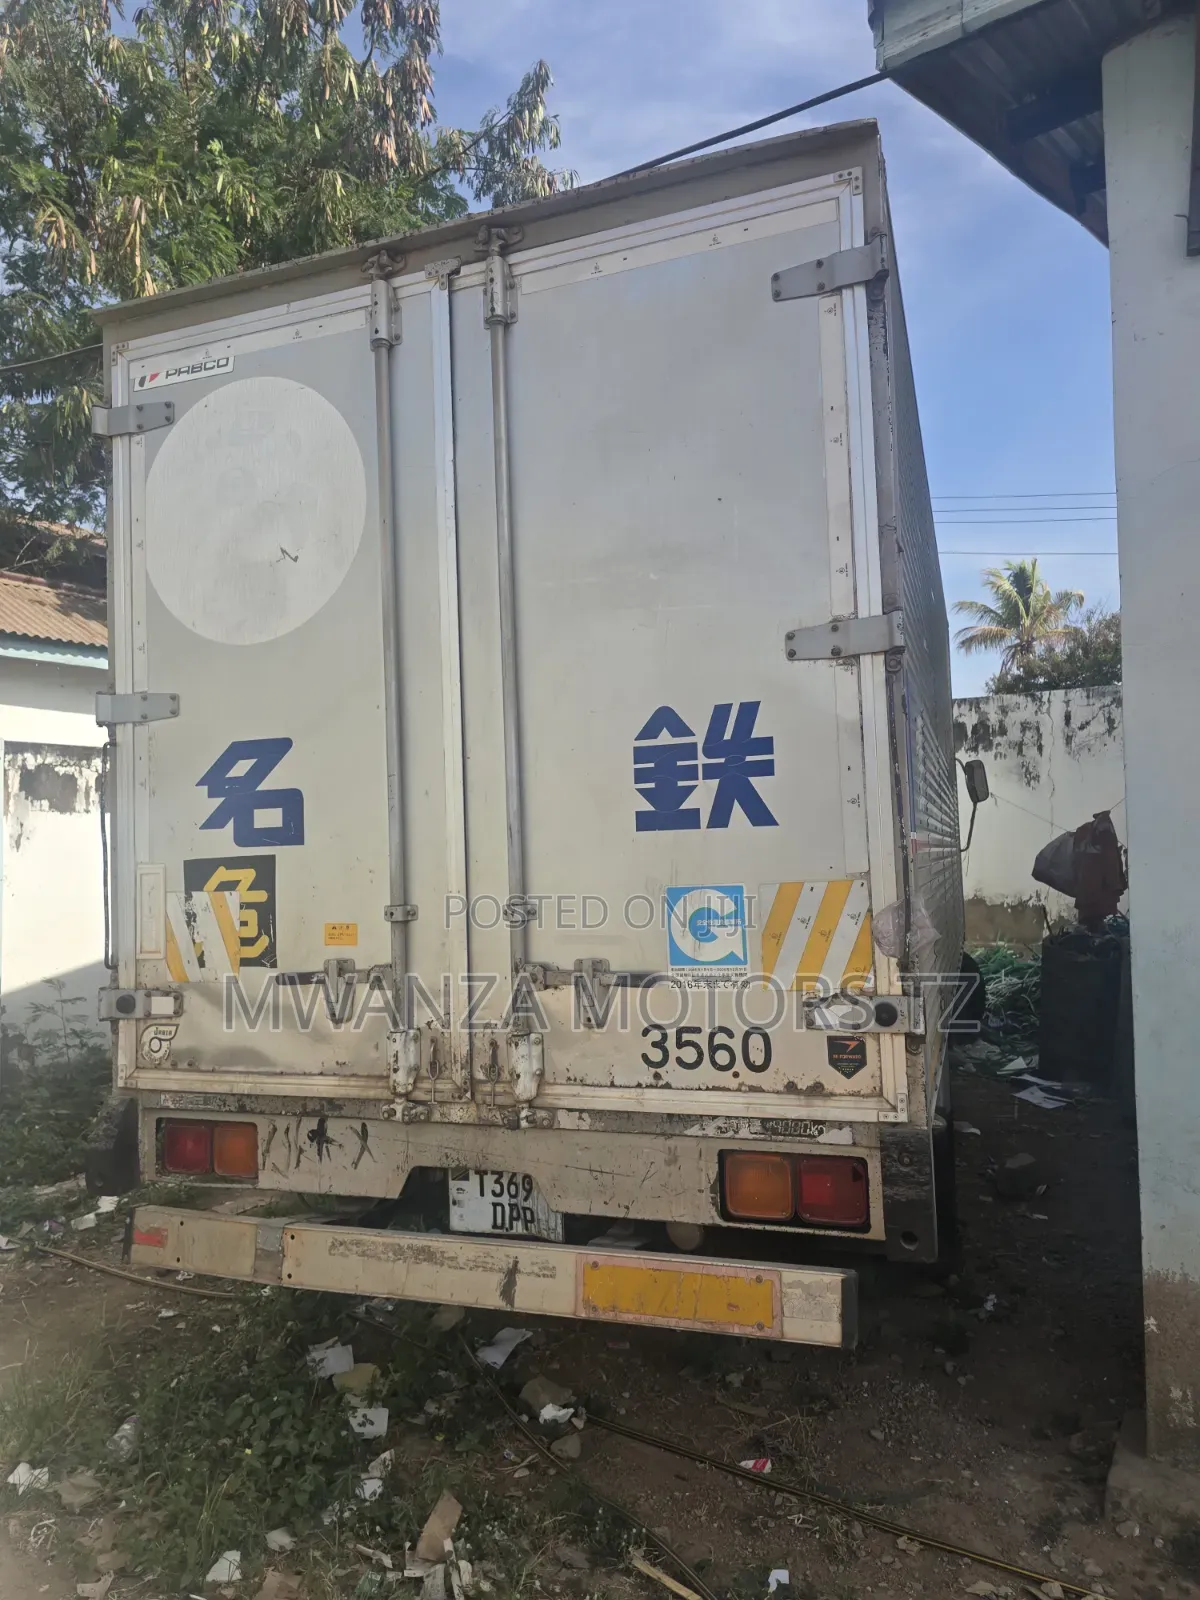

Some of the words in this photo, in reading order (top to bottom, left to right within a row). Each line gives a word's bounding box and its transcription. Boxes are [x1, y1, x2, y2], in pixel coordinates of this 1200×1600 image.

[165, 357, 229, 379] PABCO
[195, 737, 304, 848] 名
[641, 1024, 772, 1073] 3560
[474, 1170, 534, 1203] T369
[491, 1202, 535, 1232] DPP
